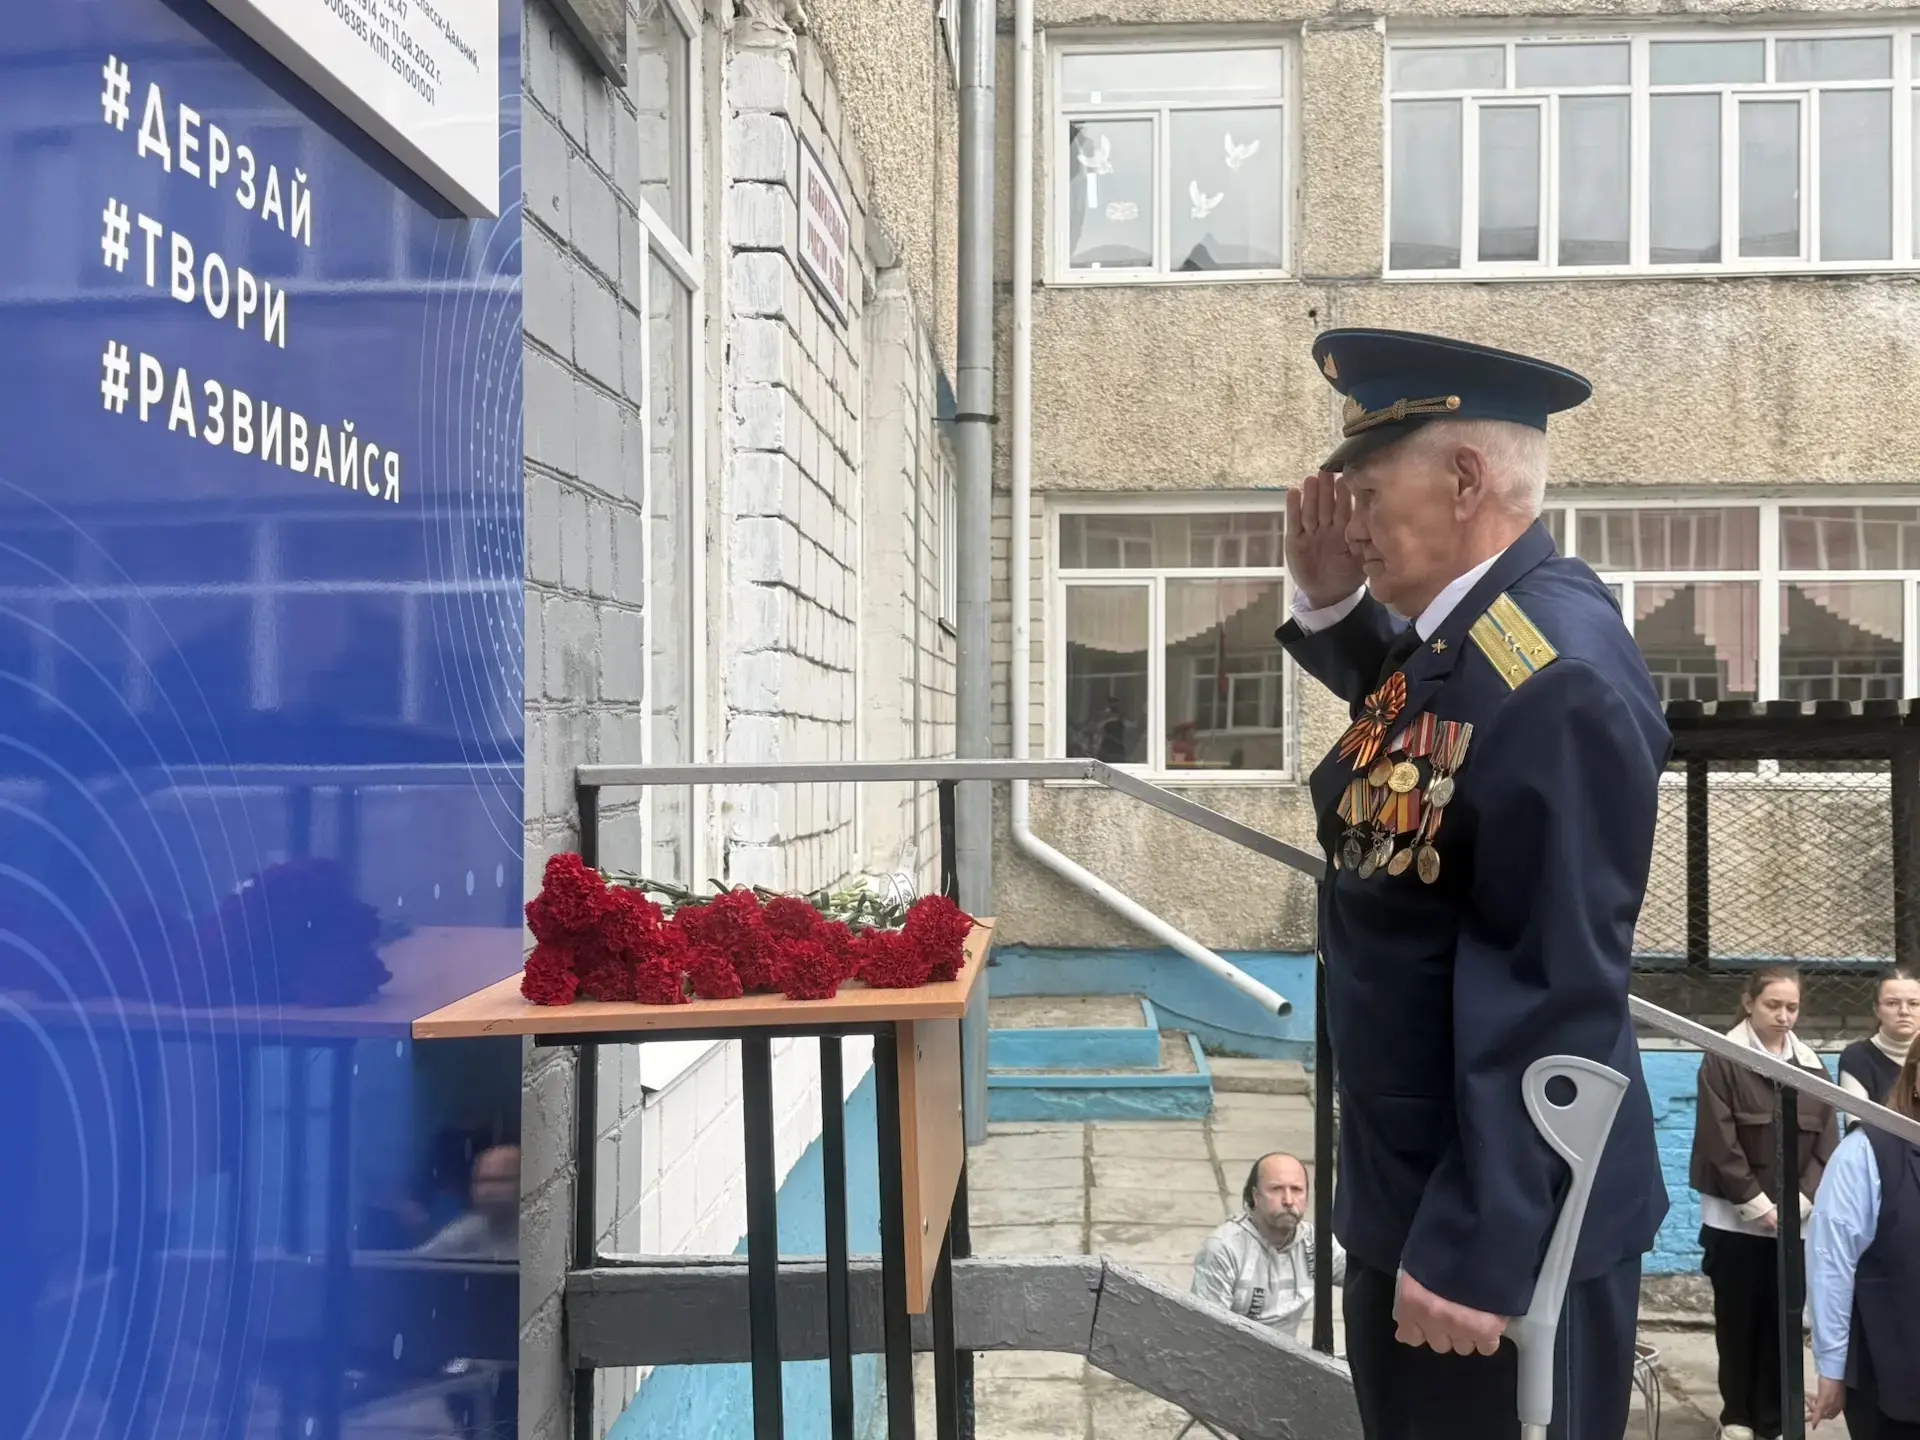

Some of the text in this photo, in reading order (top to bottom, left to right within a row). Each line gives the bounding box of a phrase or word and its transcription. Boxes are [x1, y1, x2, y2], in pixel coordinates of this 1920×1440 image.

[324, 0, 435, 107] 008385 КПП 251001001
[379, 12, 389, 33] от
[392, 20, 435, 80] 11.08.2022
[102, 56, 310, 246] #ДЕРЗАЙ
[102, 198, 284, 348] #ТВОРИ
[102, 341, 398, 503] #РАЗВИВАЙСЯ
